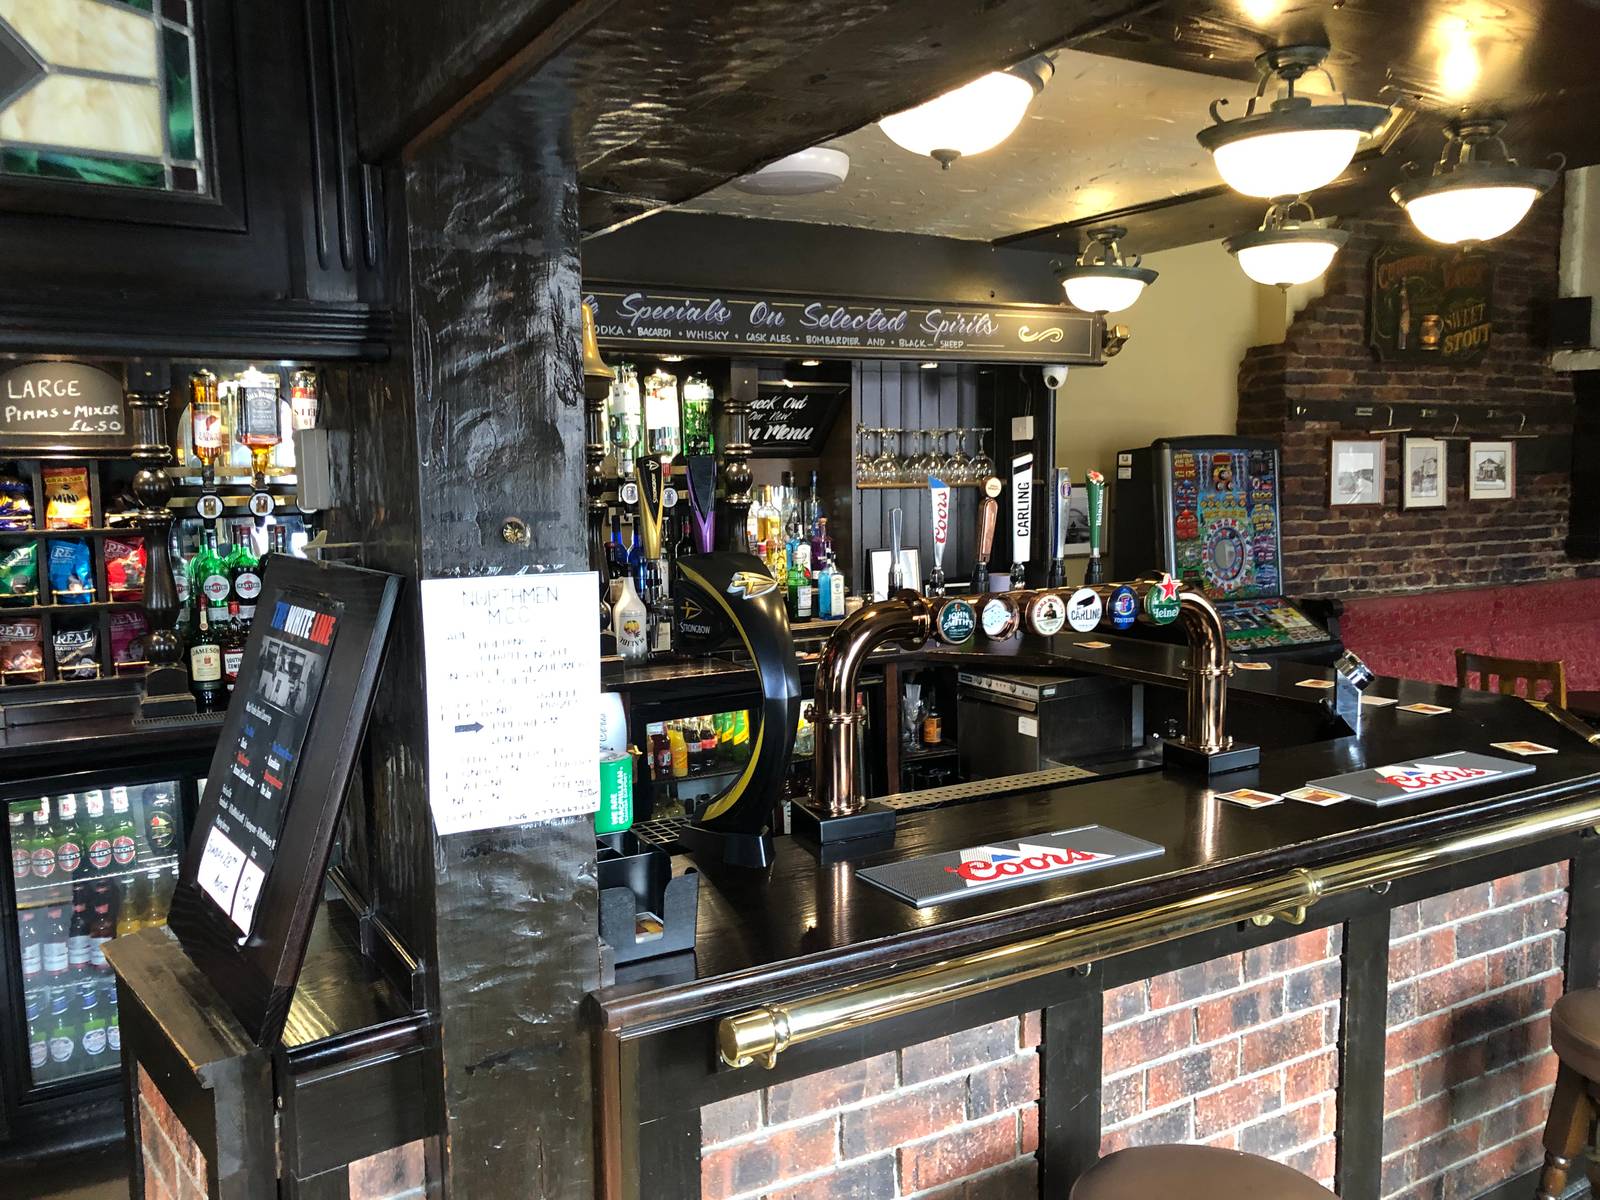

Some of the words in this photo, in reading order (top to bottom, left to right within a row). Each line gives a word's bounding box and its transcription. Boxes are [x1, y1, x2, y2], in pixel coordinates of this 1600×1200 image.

[616, 293, 731, 327] Specials
[750, 301, 785, 326] On
[799, 302, 908, 333] Selected
[920, 309, 999, 342] Spirits
[1444, 303, 1487, 330] SWEET
[593, 325, 624, 337] ODKA
[637, 327, 672, 337] BACARDI
[686, 330, 729, 341] WHISKY
[746, 333, 767, 342] CASK
[770, 333, 791, 344] ALES
[806, 335, 860, 346] BOMBARDIER
[867, 338, 885, 346] AND
[940, 340, 964, 349] SHEEP
[1443, 322, 1491, 353] STOUT
[8, 379, 81, 398] LARGE
[763, 424, 814, 441] Menu
[935, 490, 948, 545] Coors
[1017, 482, 1030, 537] CARLING
[284, 604, 317, 640] WHITE
[309, 612, 337, 647] LINE
[680, 621, 711, 634] STRONGBOW
[943, 618, 974, 631] SMITH'S
[948, 612, 970, 621] JOHN
[56, 632, 91, 643] REAL
[1376, 765, 1486, 788] Coors
[610, 793, 618, 810] ARE
[610, 809, 618, 825] WE
[944, 847, 1098, 881] Coors
